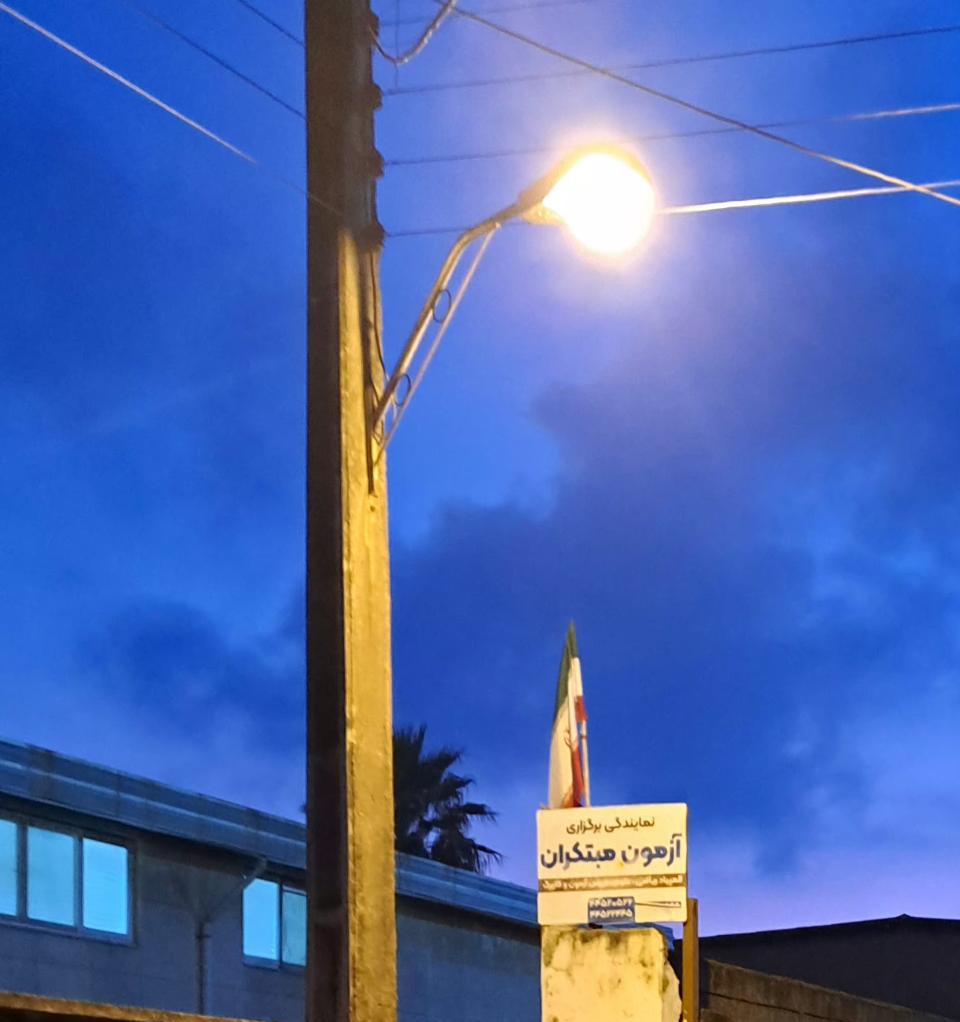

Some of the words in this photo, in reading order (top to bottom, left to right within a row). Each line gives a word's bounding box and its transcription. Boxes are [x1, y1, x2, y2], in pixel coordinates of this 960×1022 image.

[566, 819, 602, 835] برگزاری
[604, 816, 655, 833] نمایندگی
[540, 842, 616, 871] مبتکران
[620, 833, 682, 868] آزمون
